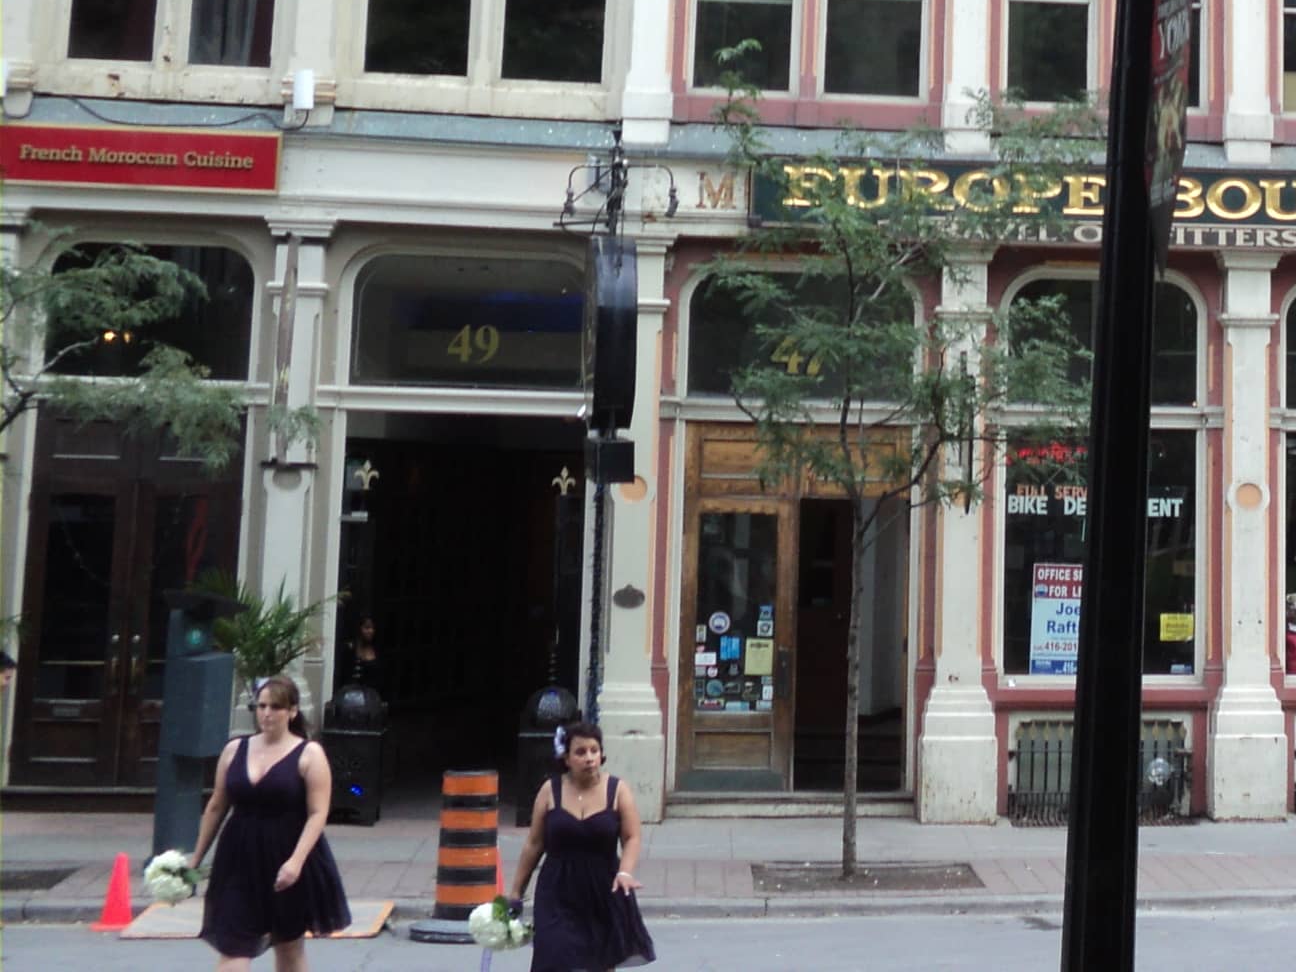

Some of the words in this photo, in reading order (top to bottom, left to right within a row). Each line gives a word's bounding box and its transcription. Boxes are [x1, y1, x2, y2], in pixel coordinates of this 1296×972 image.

[20, 144, 82, 162] French
[89, 148, 177, 166] Moroccan
[184, 152, 253, 169] Cuisine
[448, 324, 500, 364] 49
[1055, 485, 1088, 499] SERV
[1008, 494, 1048, 515] BIKE
[1037, 569, 1070, 580] OFFICE
[1049, 585, 1067, 597] FOR
[1047, 620, 1076, 634] Raft
